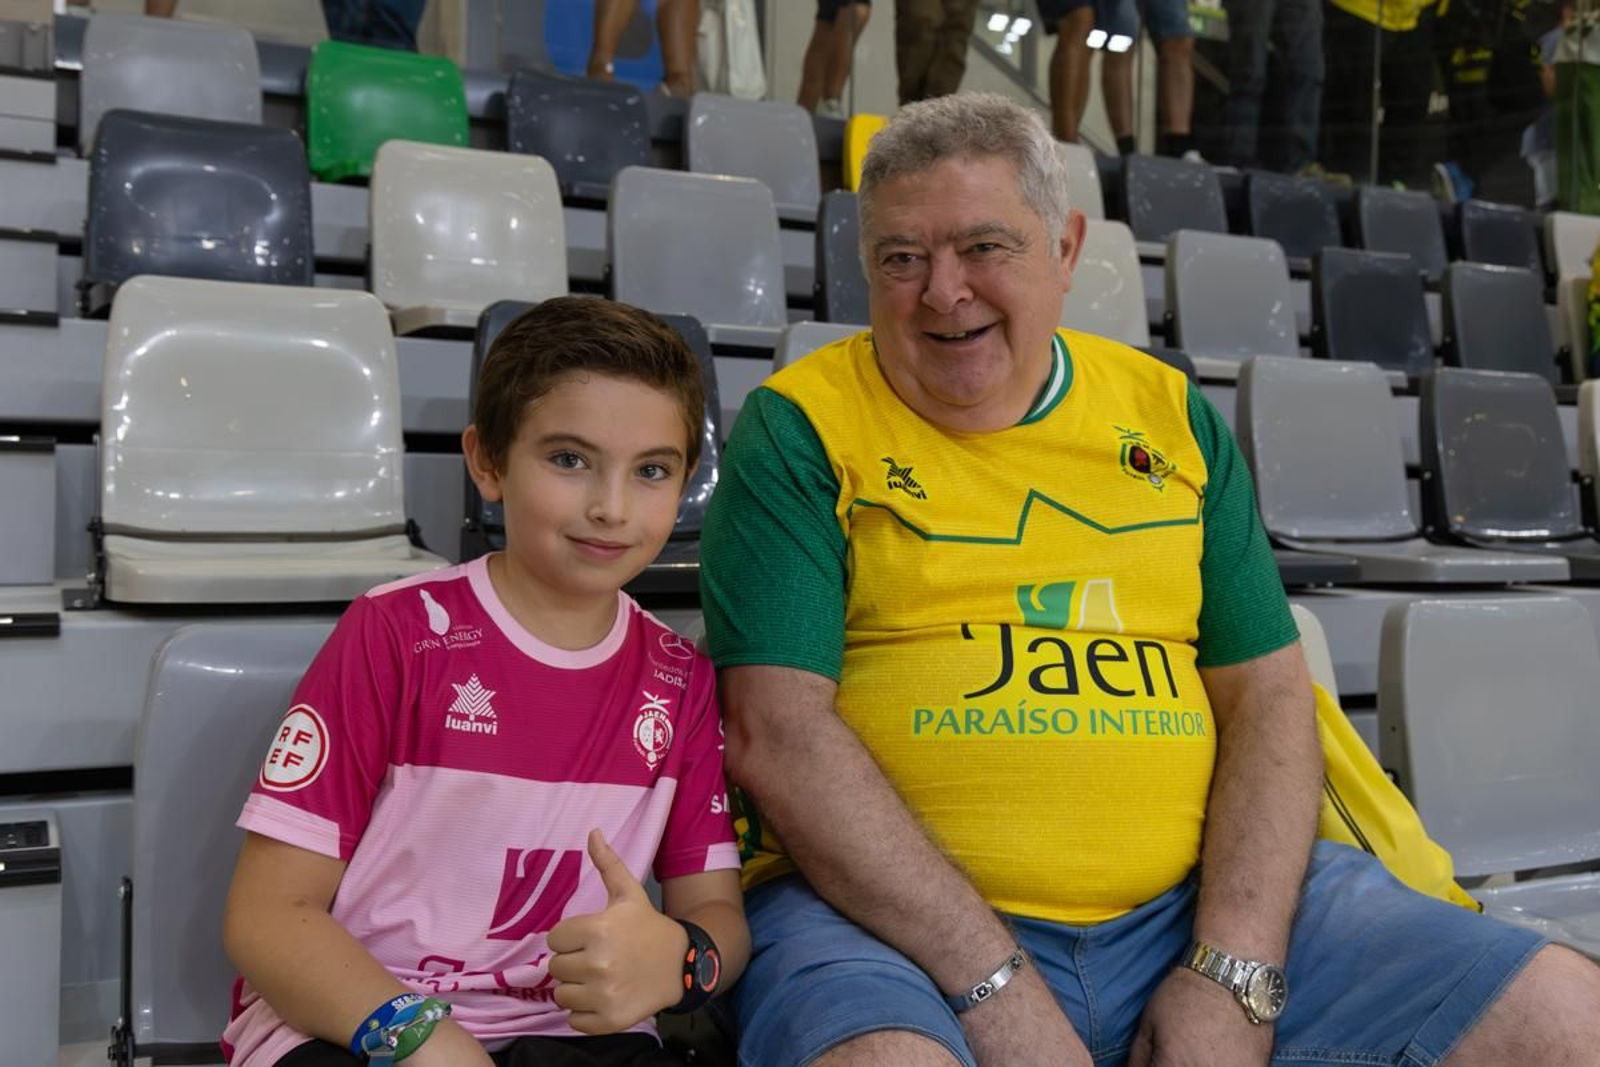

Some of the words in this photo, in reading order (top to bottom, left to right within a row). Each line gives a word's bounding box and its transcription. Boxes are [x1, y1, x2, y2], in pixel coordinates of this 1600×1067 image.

[445, 714, 498, 736] luanvi
[913, 700, 1079, 736] PARAÍSO
[1089, 708, 1207, 737] INTERIOR
